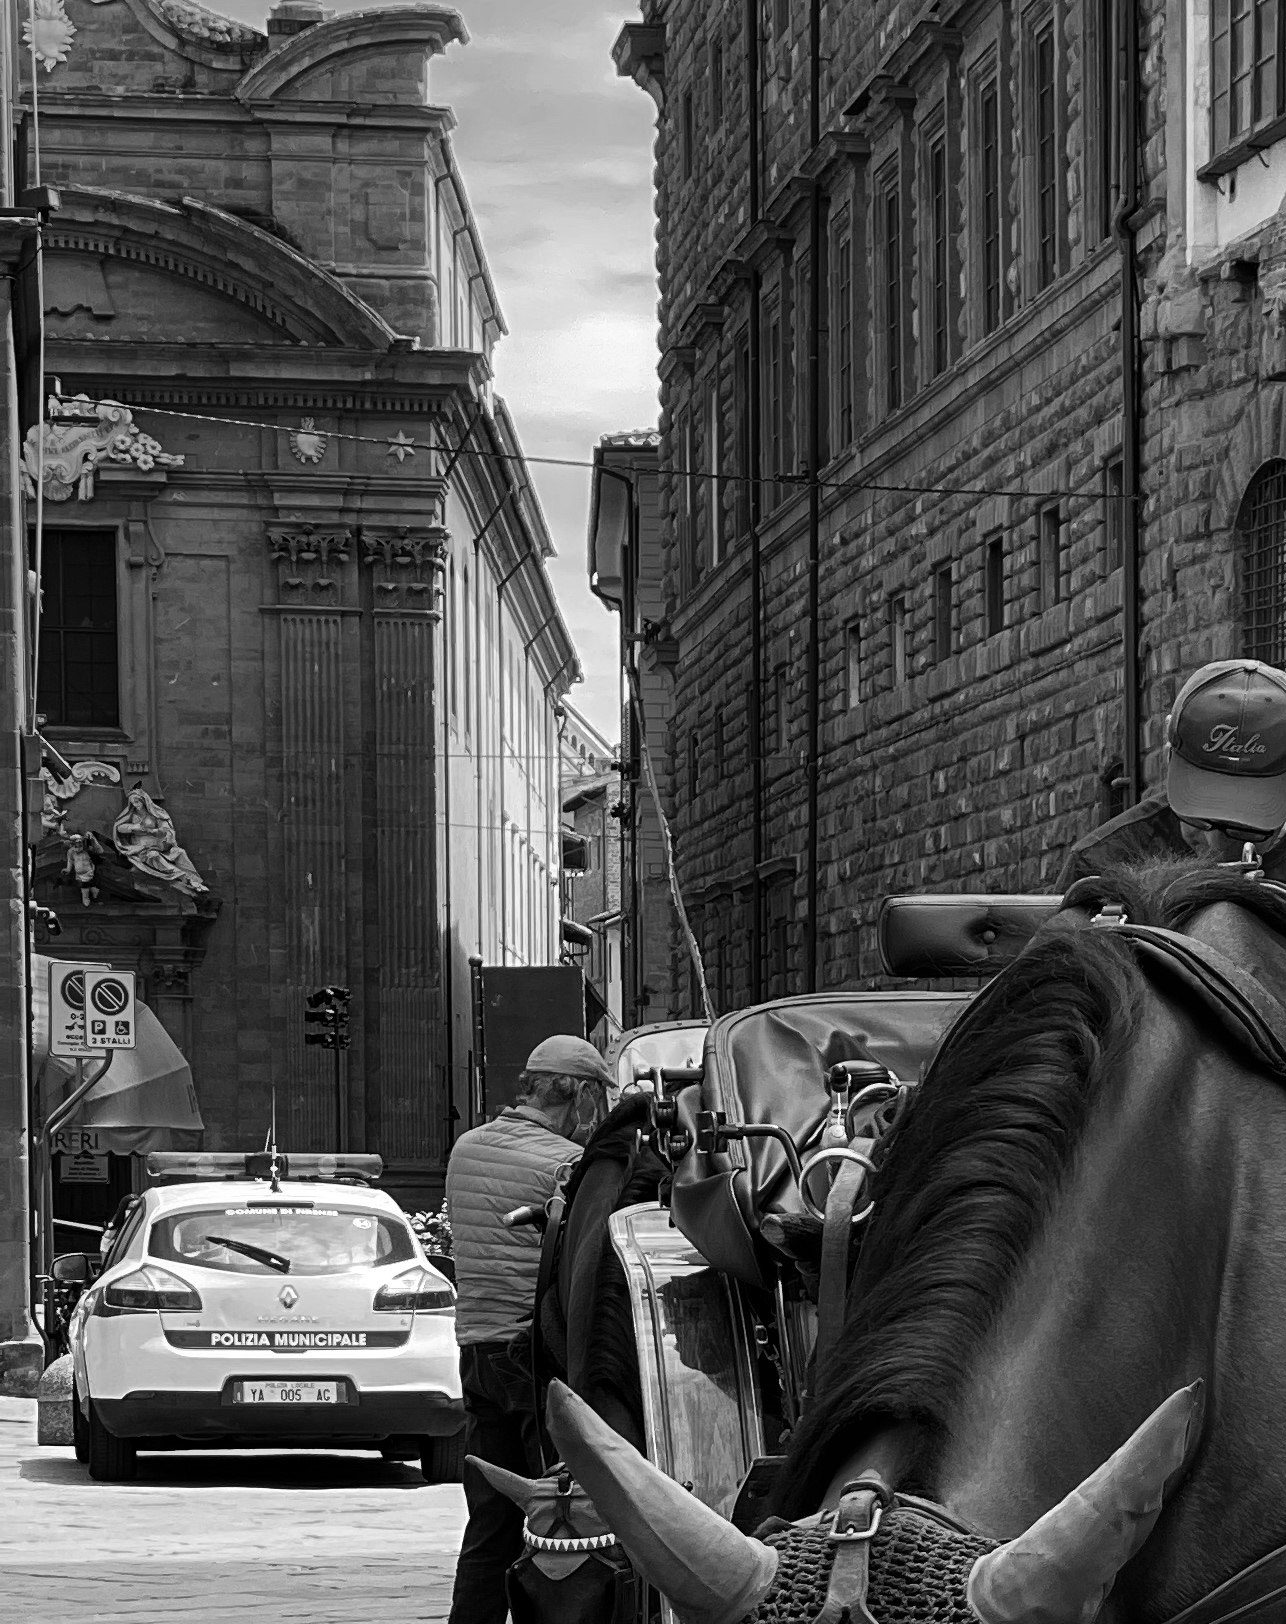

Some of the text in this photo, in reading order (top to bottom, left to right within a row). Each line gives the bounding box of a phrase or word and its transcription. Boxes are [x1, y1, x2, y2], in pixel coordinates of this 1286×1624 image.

[1202, 724, 1266, 753] Italia
[210, 1332, 367, 1346] POLIZIA MUNICIPALE
[250, 1389, 265, 1402] YA
[280, 1388, 302, 1402] 005
